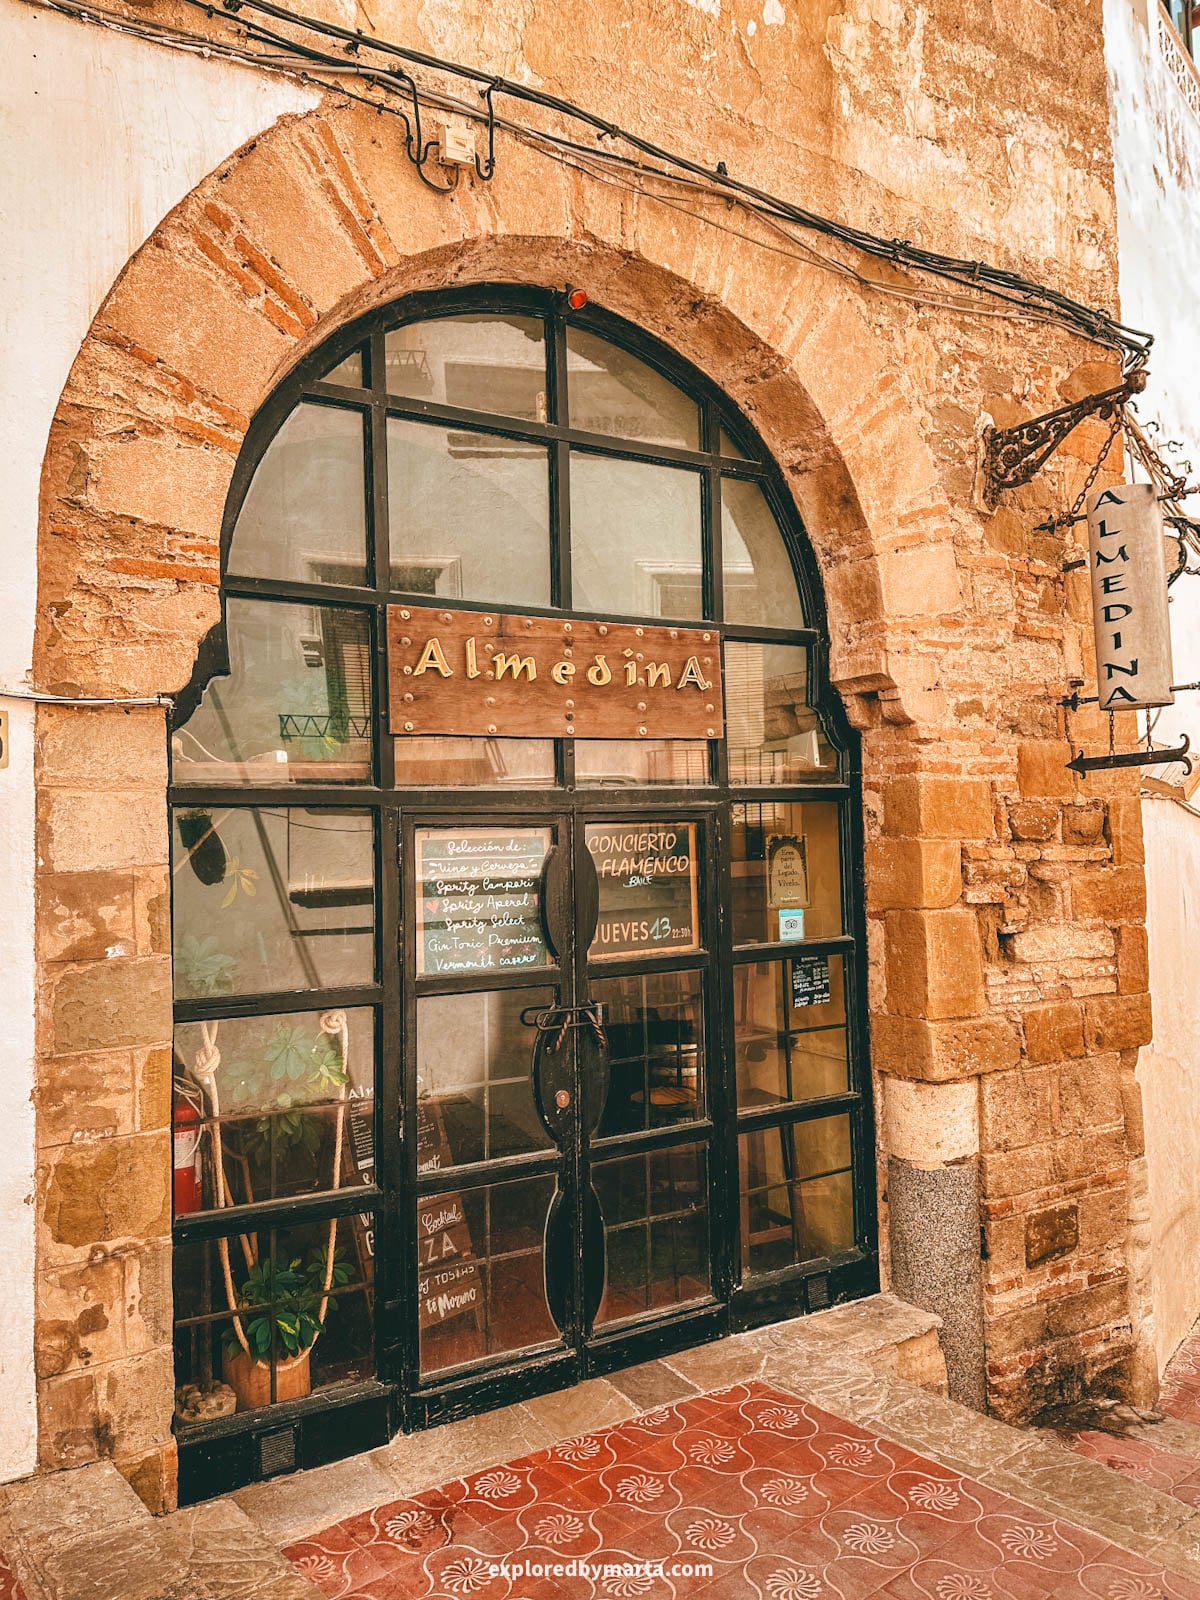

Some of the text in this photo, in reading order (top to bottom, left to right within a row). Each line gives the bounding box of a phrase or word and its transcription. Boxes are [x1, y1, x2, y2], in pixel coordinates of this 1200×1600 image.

[1093, 489, 1139, 706] ALMEDINA
[448, 840, 504, 855] Selección
[588, 832, 677, 854] CONCIERTO
[438, 861, 528, 877] Vino y Cerveza
[602, 855, 690, 878] FLAMENCO
[436, 877, 534, 896] Spritz Campari
[442, 893, 530, 913] Spritz Aperol
[445, 912, 525, 934] Spritz Select
[592, 921, 649, 944] JUEVES
[649, 917, 671, 940] 13
[428, 933, 542, 952] Gin Tonic Premium
[435, 954, 537, 971] Vermouth casero
